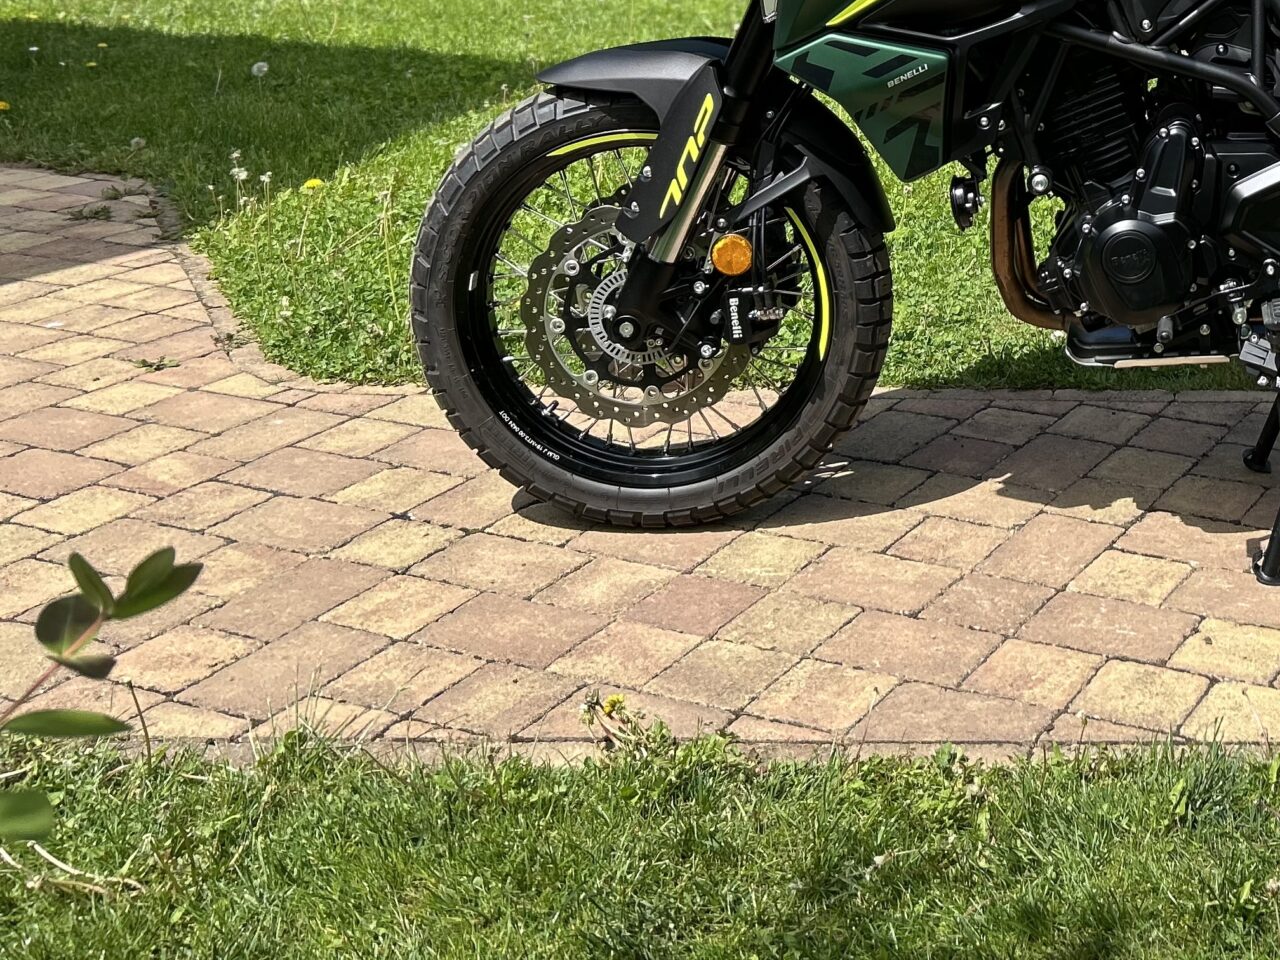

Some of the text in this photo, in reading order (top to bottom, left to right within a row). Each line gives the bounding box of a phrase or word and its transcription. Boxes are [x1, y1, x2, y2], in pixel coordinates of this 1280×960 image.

[886, 63, 929, 89] BENELLI
[729, 297, 743, 339] Benelli
[499, 410, 510, 421] DOT
